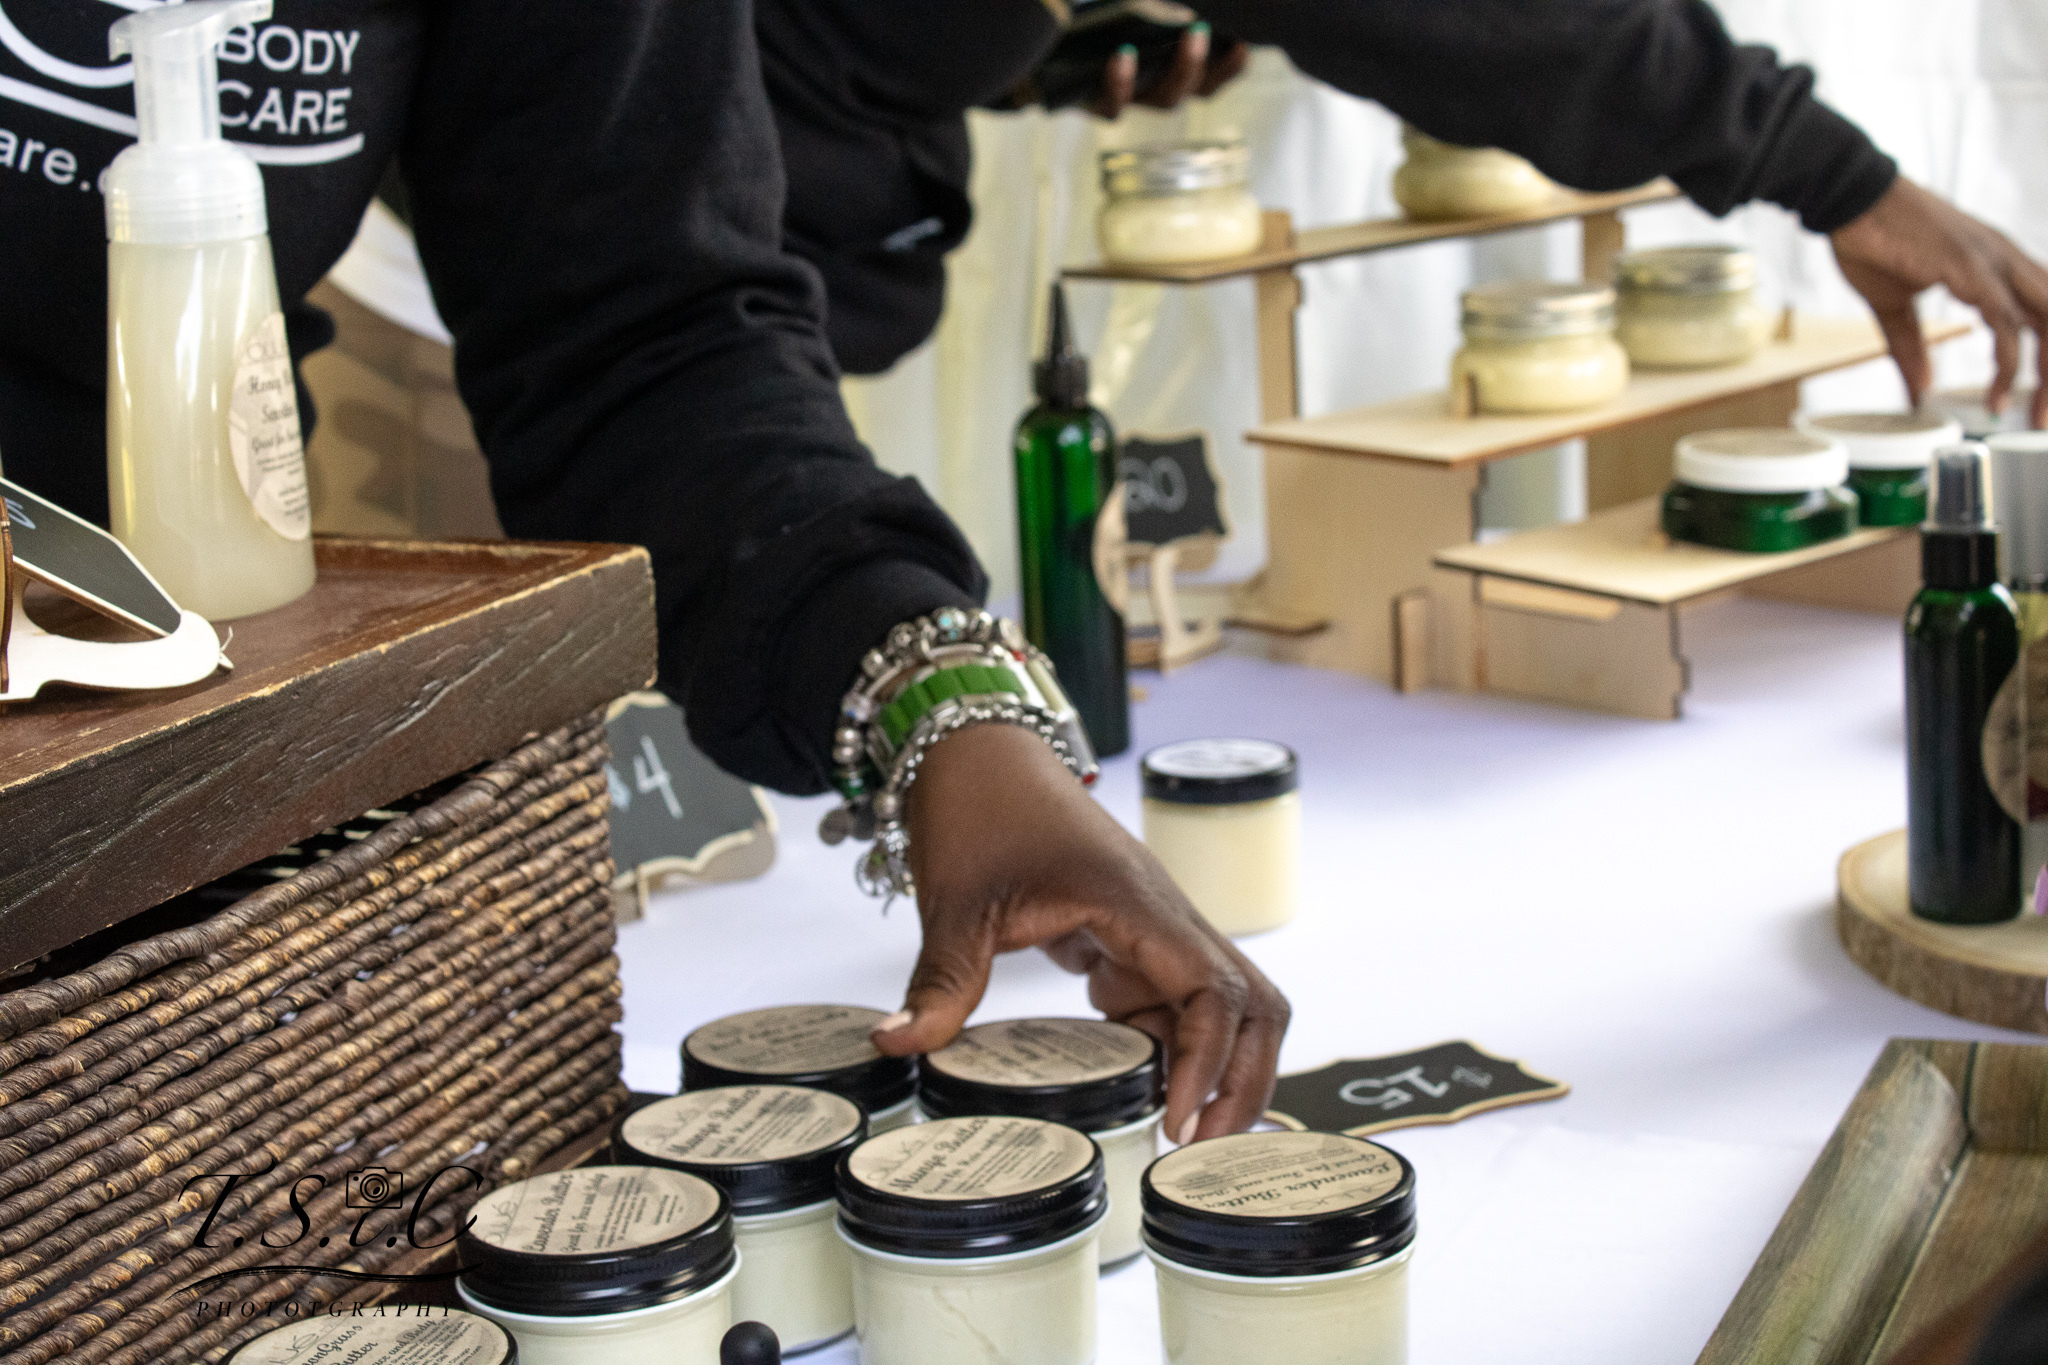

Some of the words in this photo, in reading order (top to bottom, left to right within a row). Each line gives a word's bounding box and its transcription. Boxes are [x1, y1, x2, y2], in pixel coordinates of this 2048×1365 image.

[217, 23, 360, 75] BODY
[218, 79, 353, 135] CARE
[1284, 1162, 1389, 1190] Lavender
[1202, 1189, 1280, 1208] Butter
